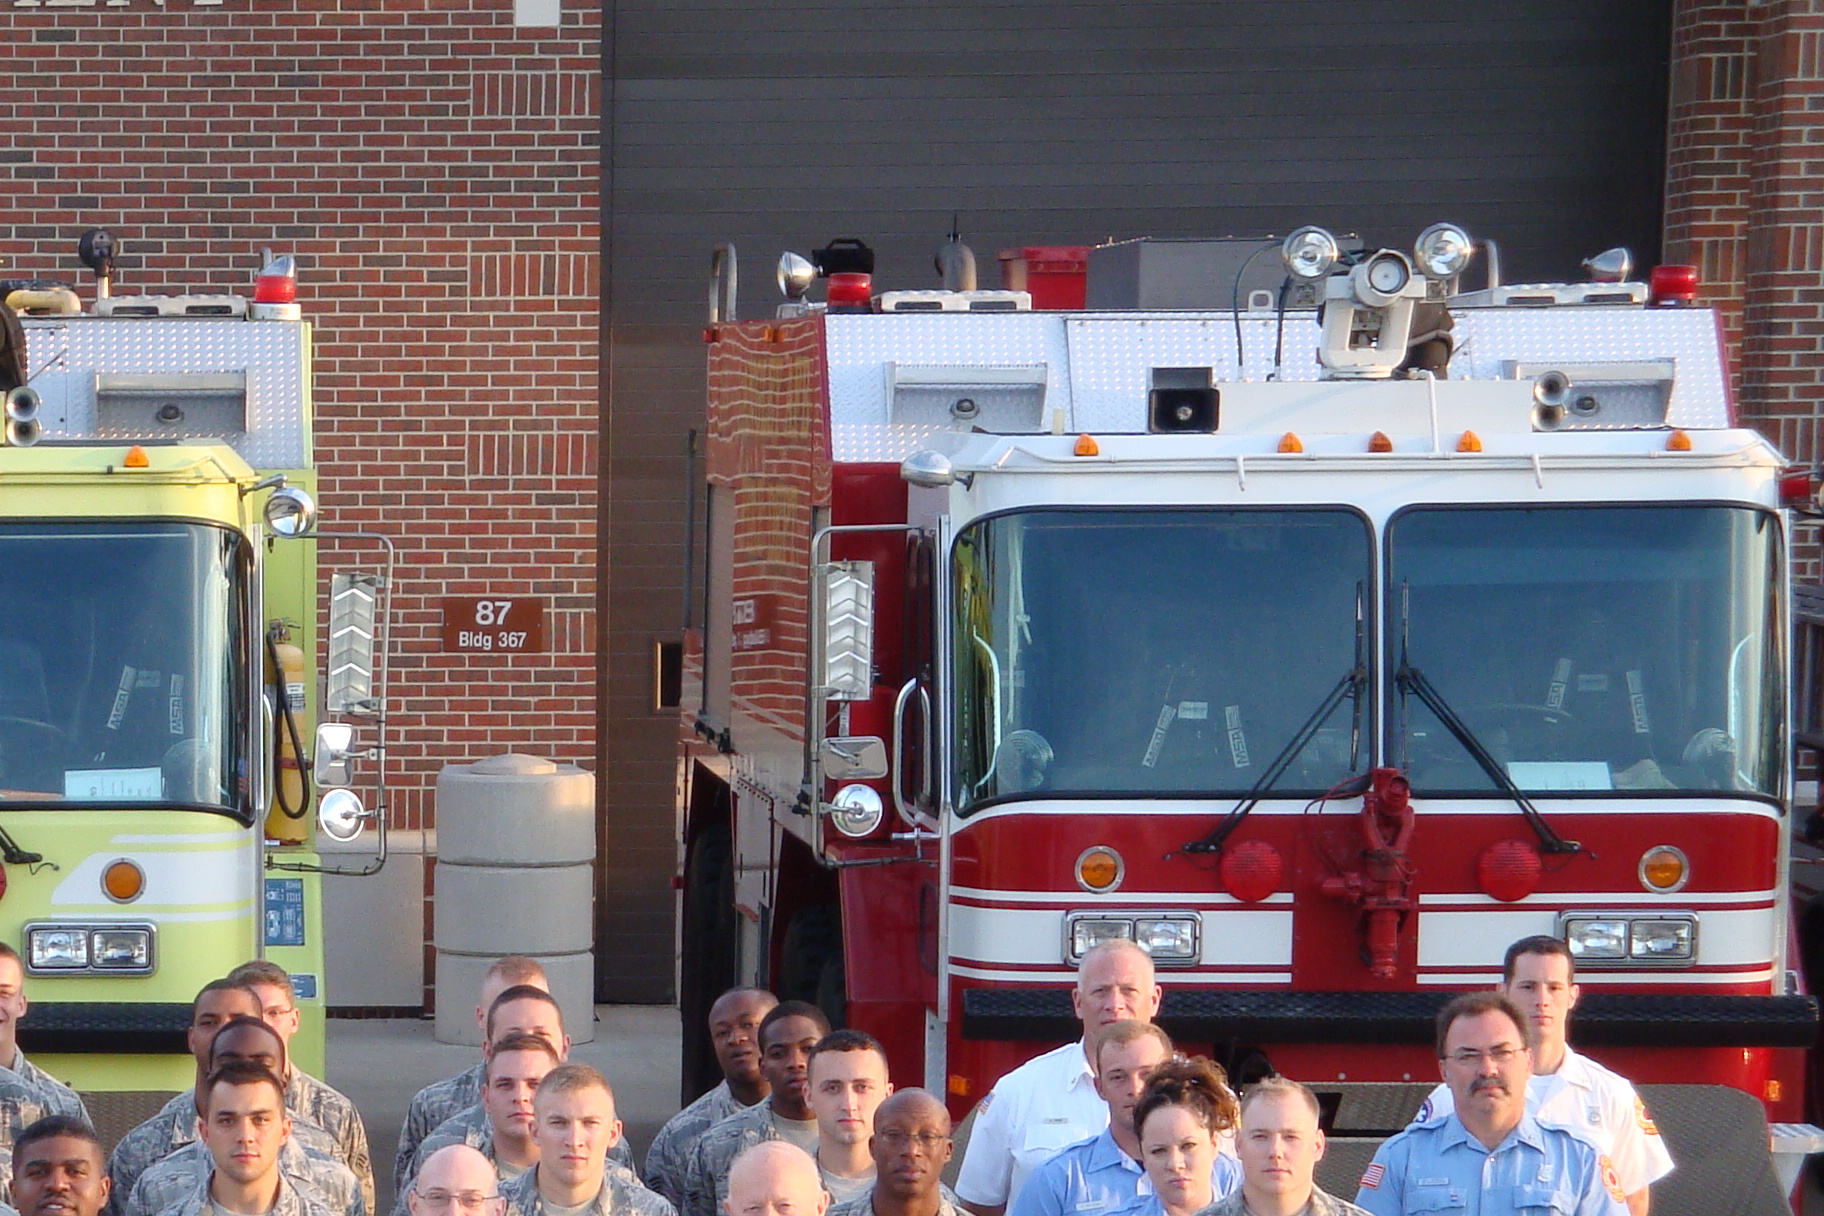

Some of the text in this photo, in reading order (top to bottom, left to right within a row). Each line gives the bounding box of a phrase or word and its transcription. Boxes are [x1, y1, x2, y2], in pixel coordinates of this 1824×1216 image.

[475, 600, 512, 625] 87
[459, 631, 527, 651] Bldg 367
[170, 698, 183, 732] MSA
[1230, 730, 1249, 765] MSA
